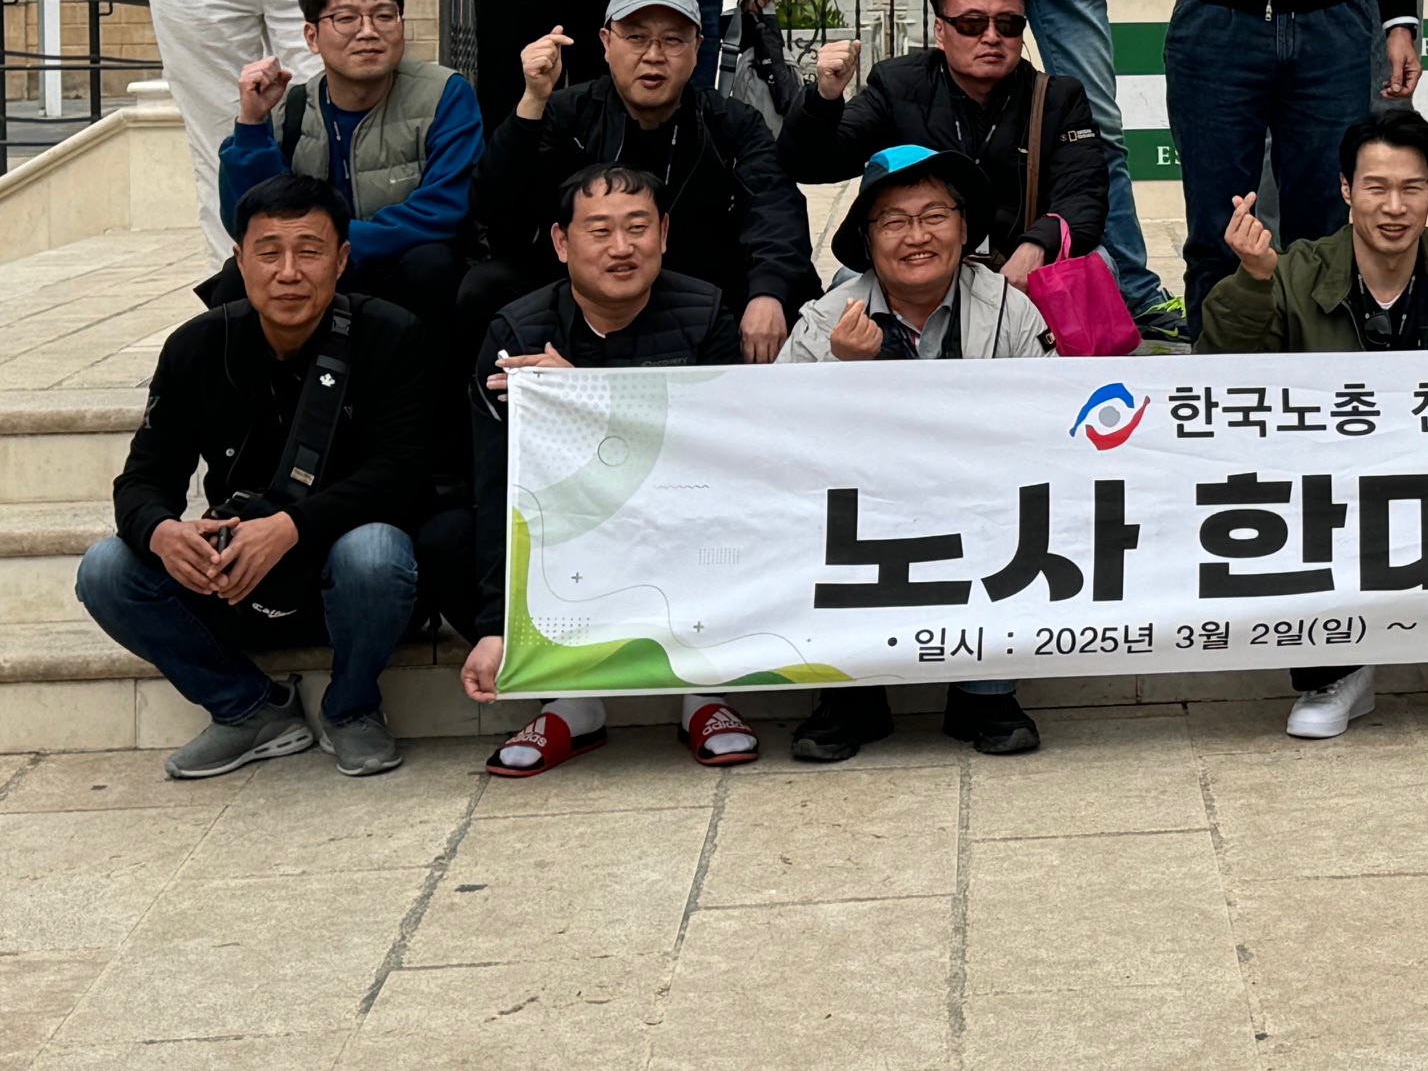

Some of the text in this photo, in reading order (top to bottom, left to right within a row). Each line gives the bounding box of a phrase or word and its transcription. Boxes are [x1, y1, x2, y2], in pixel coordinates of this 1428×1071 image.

[1168, 383, 1381, 439] 한국노총
[813, 479, 1141, 609] 노사
[914, 626, 984, 663] 일시
[1034, 622, 1154, 657] 2025년
[1174, 620, 1231, 651] 3월
[1249, 615, 1367, 648] 2일(일)
